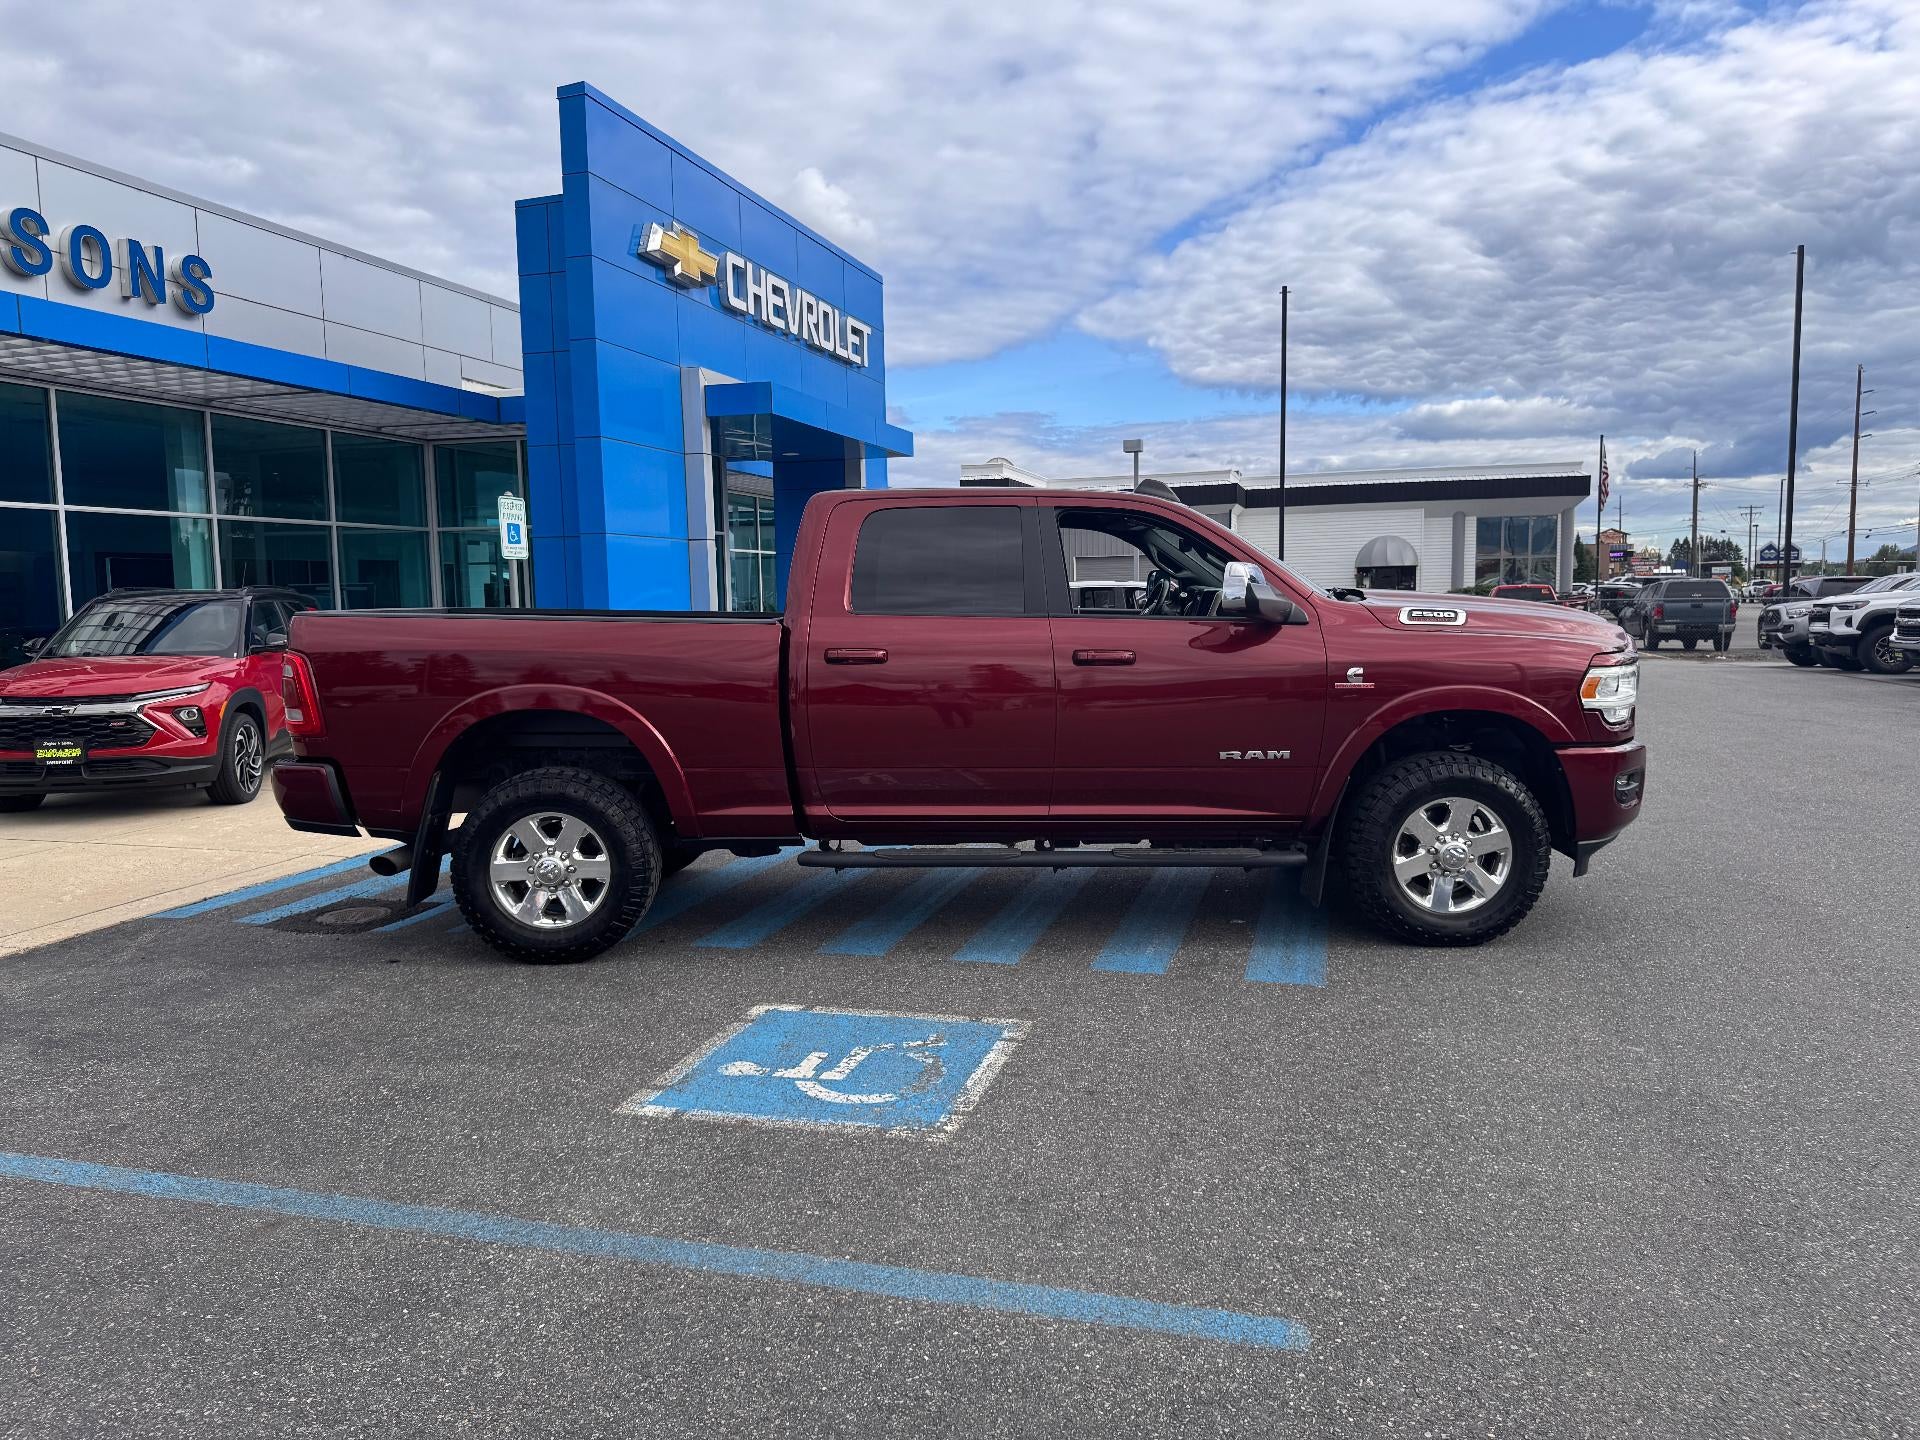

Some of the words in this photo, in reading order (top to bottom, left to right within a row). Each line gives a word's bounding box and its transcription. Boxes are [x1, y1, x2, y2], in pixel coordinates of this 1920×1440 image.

[0, 206, 215, 315] SONS
[718, 252, 871, 368] CHEVROLET
[1219, 750, 1291, 760] RAM
